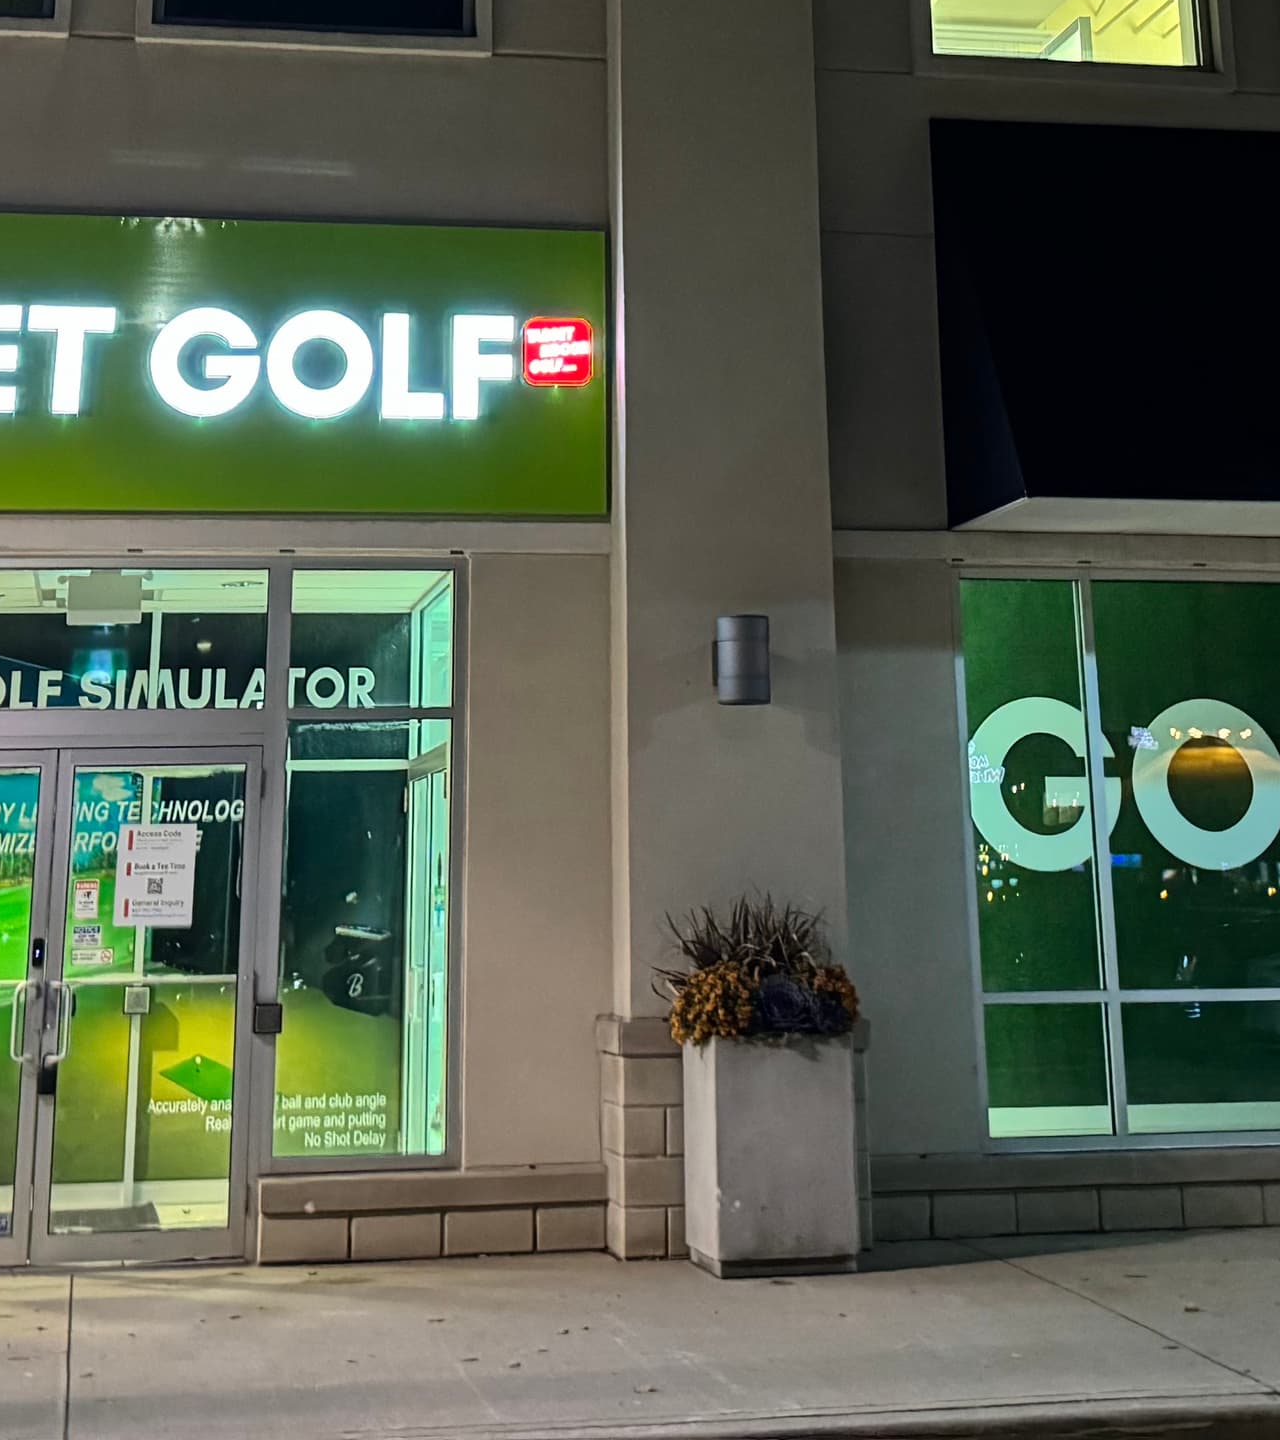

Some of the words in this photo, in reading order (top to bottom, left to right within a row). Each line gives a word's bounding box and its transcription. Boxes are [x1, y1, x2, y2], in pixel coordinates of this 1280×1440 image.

[148, 304, 516, 421] GOLF
[78, 666, 377, 710] SIMULATOR
[136, 830, 162, 838] Access
[163, 830, 182, 838] Code
[148, 1097, 208, 1116] Accurately
[282, 1094, 302, 1109] ball
[304, 1092, 326, 1109] and
[329, 1092, 353, 1109] club
[355, 1092, 387, 1111] angle
[289, 1115, 321, 1133] game
[323, 1112, 345, 1128] and
[348, 1111, 386, 1129] putting
[304, 1131, 321, 1148] No
[324, 1130, 351, 1147] Shot
[353, 1130, 386, 1150] Delay
